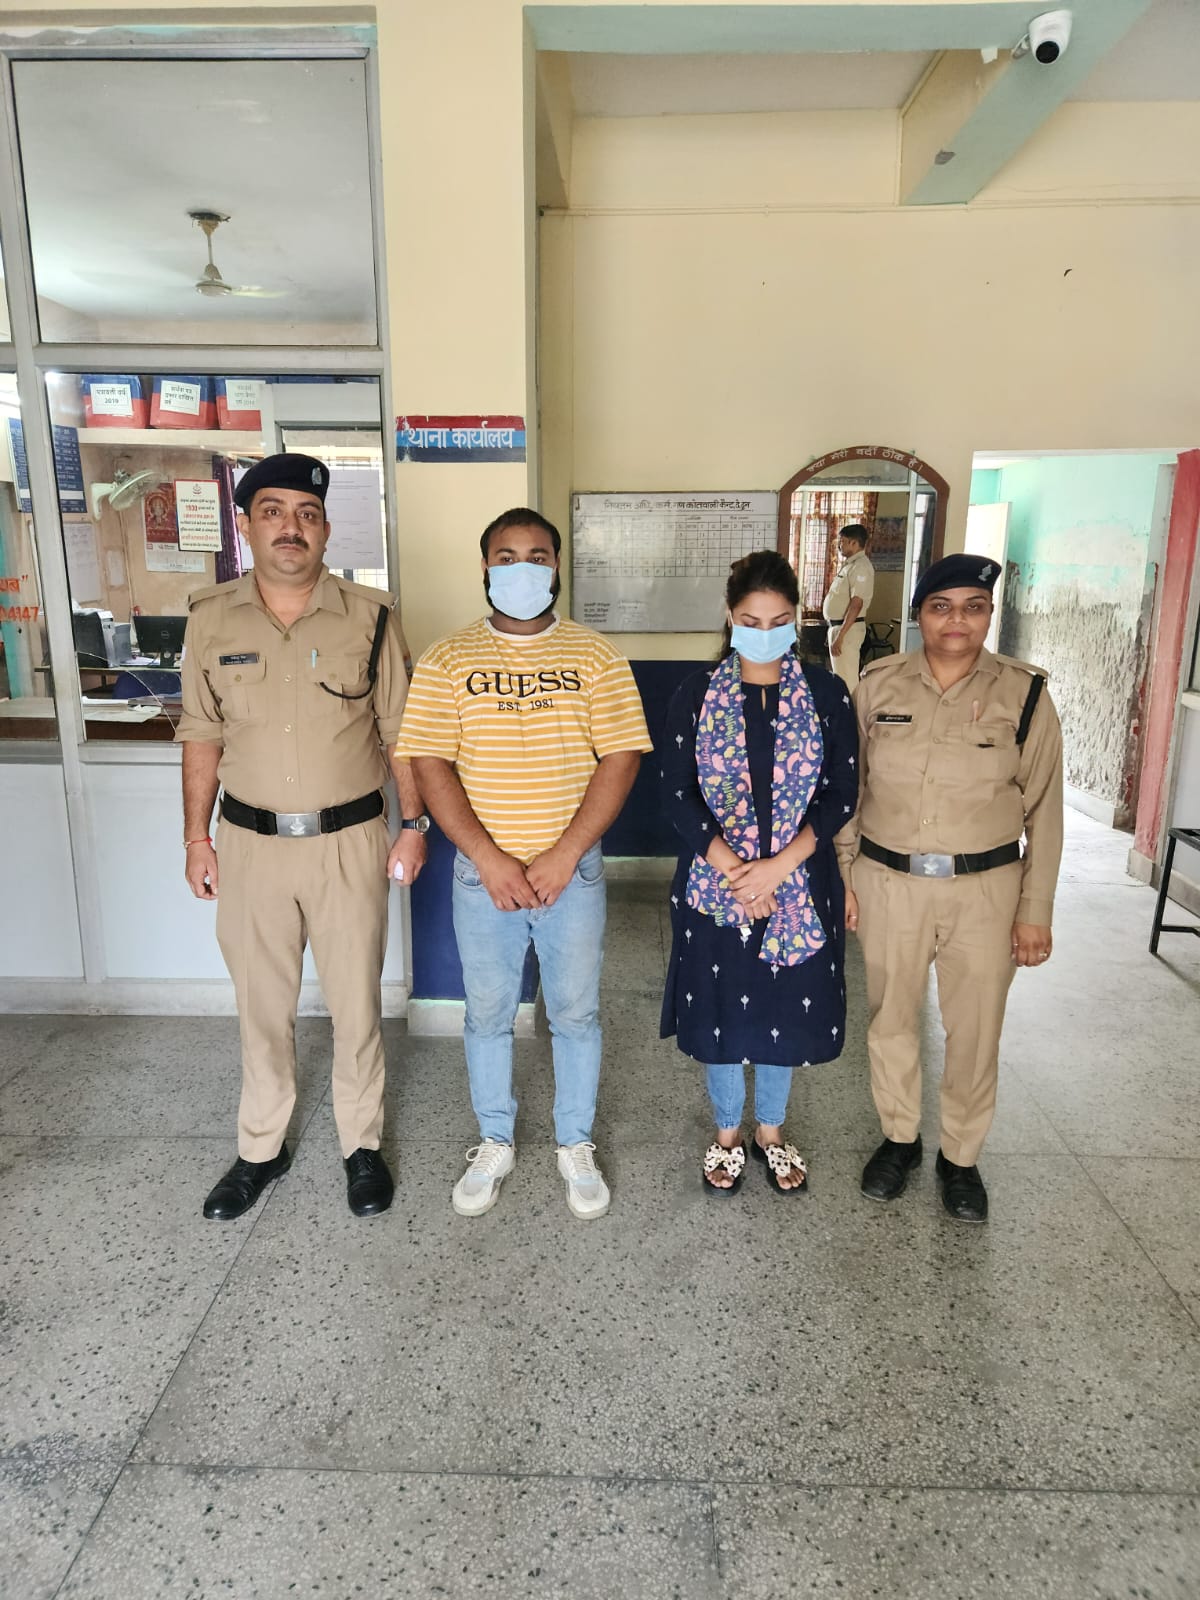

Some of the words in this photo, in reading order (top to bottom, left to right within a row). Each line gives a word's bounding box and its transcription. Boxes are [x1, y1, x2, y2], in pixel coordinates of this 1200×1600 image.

[407, 428, 450, 449] थाना
[452, 420, 516, 449] कार्यालय
[806, 458, 826, 472] क्या
[830, 448, 849, 460] मेरी
[856, 446, 879, 457] वर्दी
[882, 447, 905, 461] ठीक
[466, 669, 582, 698] GUESS
[497, 700, 523, 712] EST.
[530, 698, 555, 711] 1981
